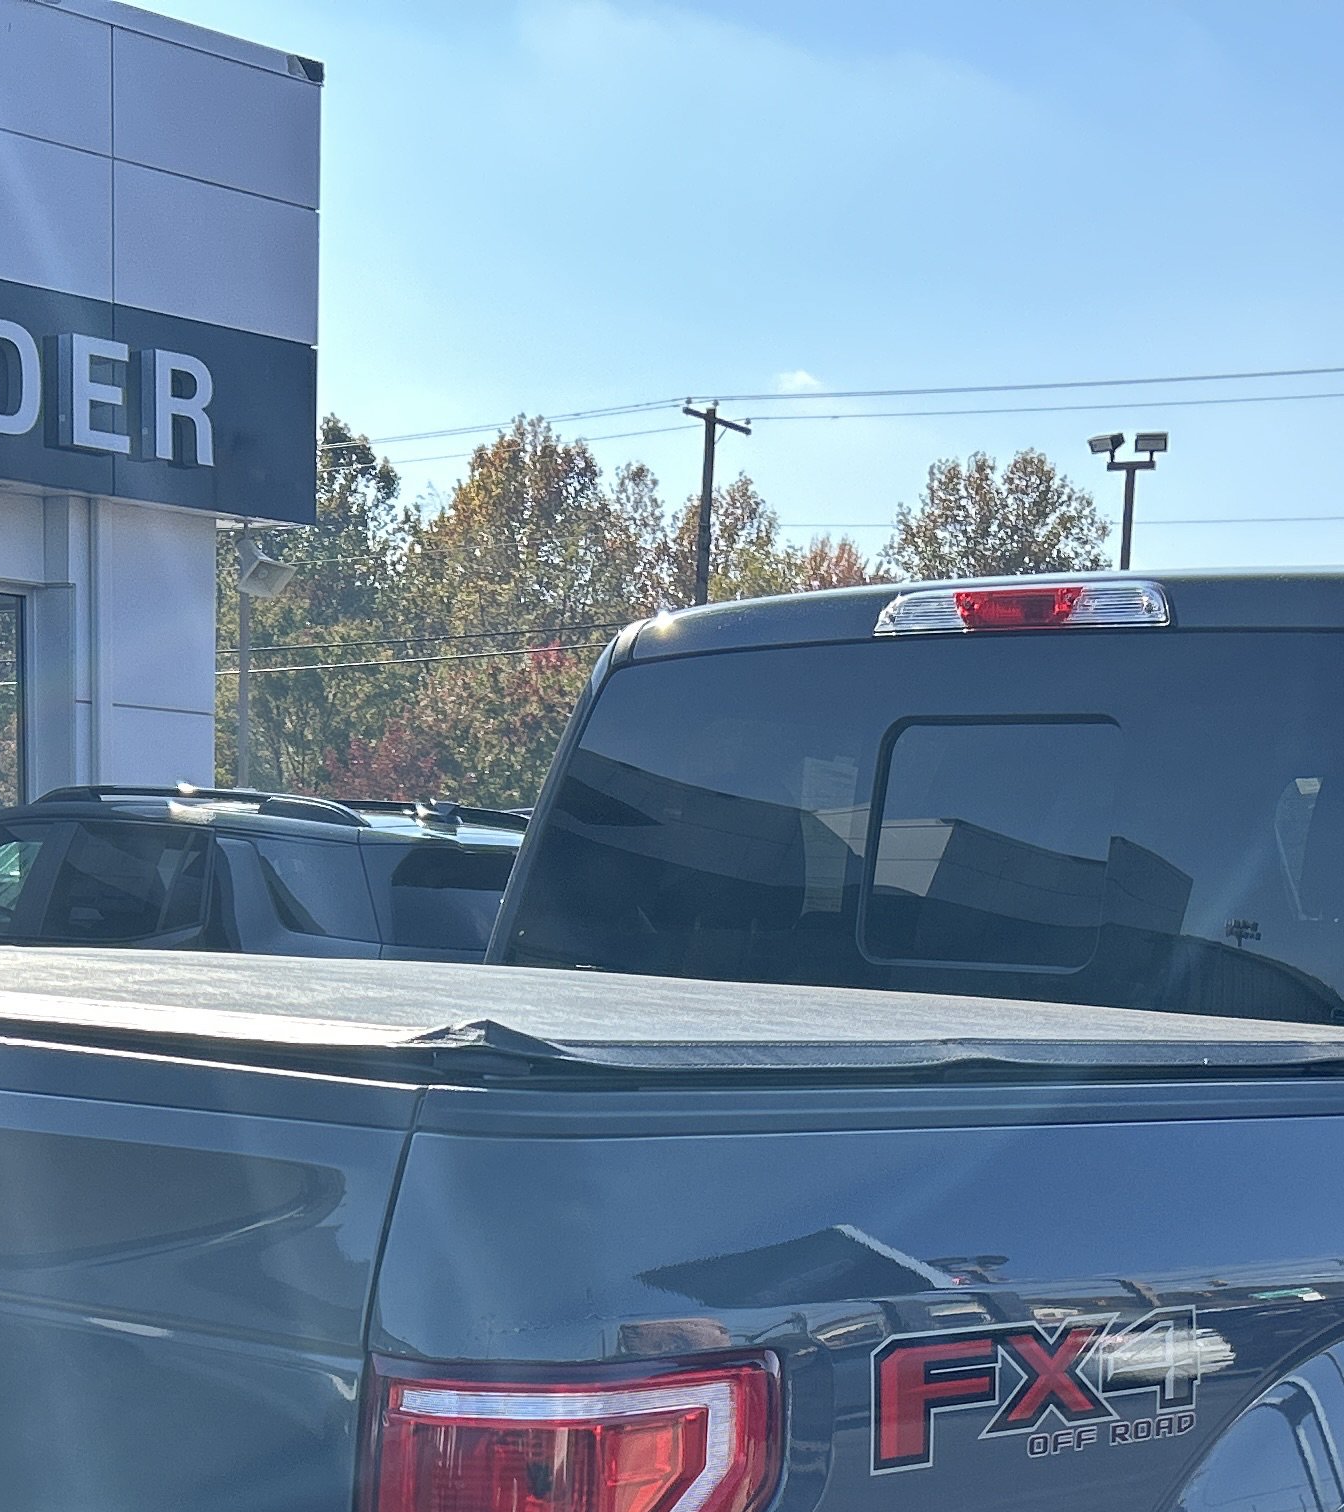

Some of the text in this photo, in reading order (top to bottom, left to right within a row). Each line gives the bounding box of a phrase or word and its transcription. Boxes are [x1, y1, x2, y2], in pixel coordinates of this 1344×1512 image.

[870, 1305, 1201, 1476] FX4
[1026, 1411, 1197, 1459] OFF ROAD
